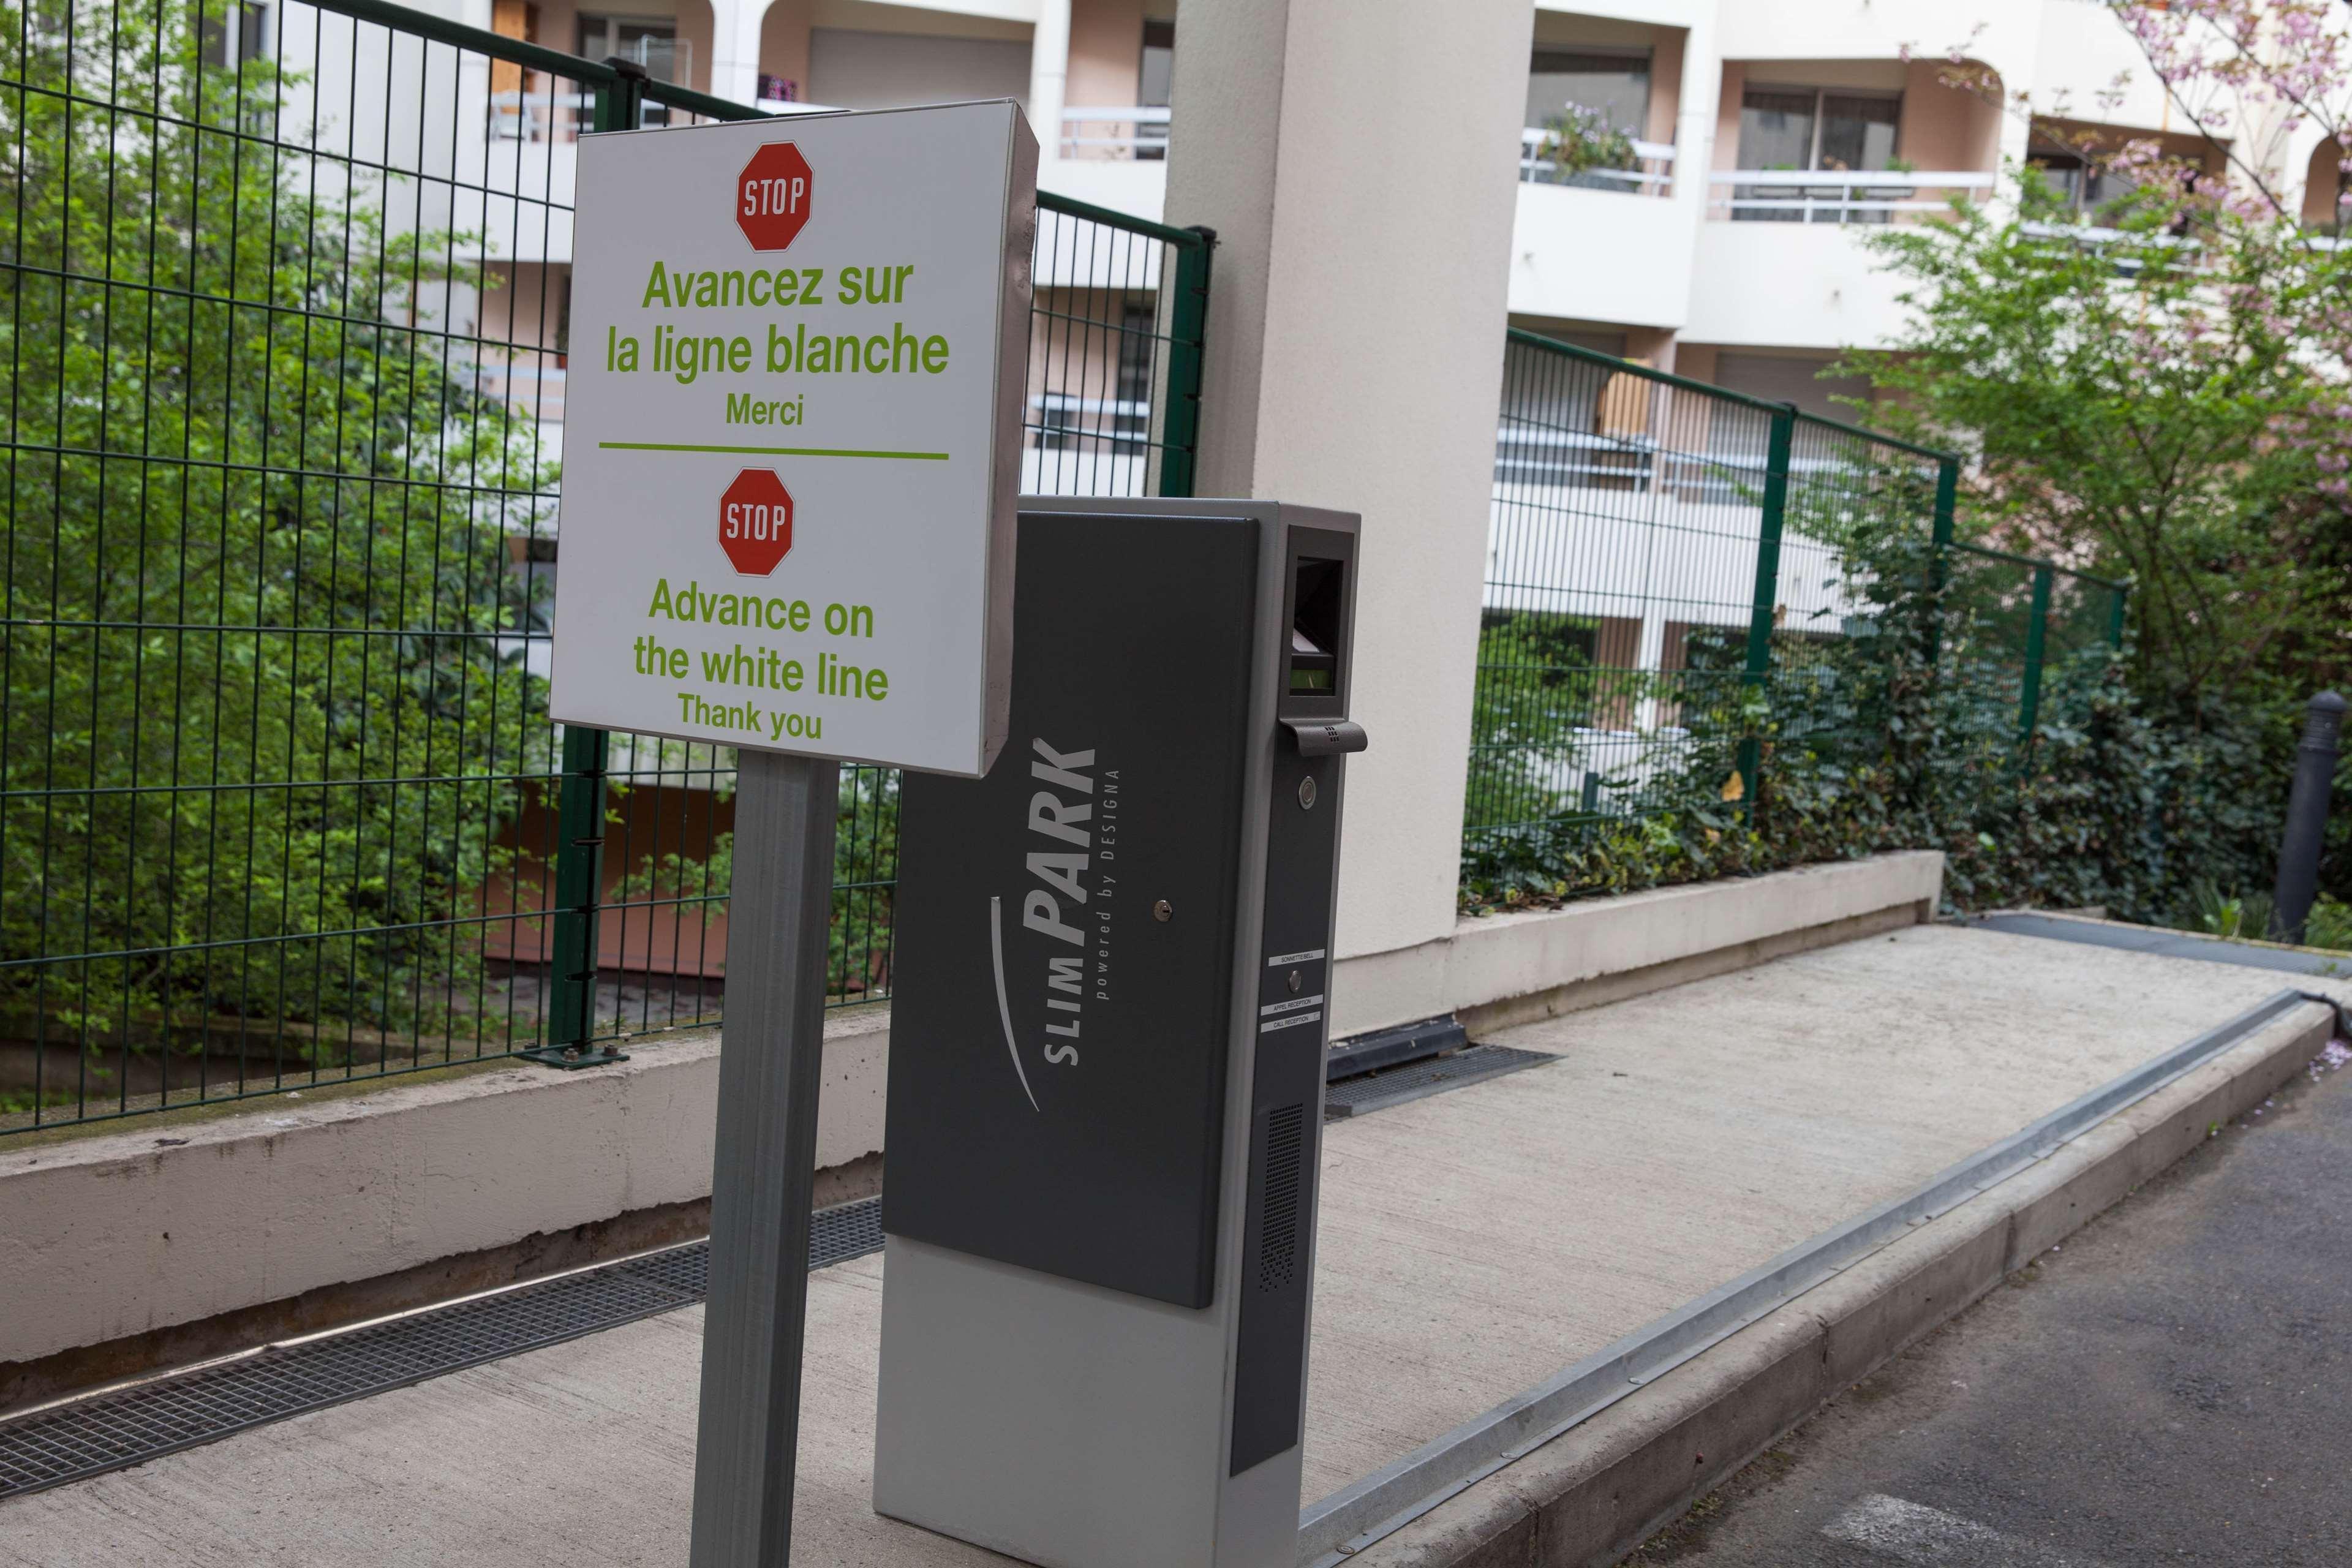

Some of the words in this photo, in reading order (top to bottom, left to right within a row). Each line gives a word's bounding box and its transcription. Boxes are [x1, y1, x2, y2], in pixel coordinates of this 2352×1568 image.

[745, 178, 804, 216] STOP
[643, 262, 823, 307] Avancez
[839, 265, 913, 304] sur
[608, 326, 638, 372] la
[654, 326, 751, 384] ligne
[767, 323, 948, 373] blanche
[727, 393, 803, 424] Merci
[727, 503, 785, 540] STOP
[649, 579, 810, 631] Advance
[825, 604, 872, 637] on
[634, 636, 688, 679] the
[702, 645, 803, 692] white
[818, 653, 888, 700] line
[678, 693, 761, 731] Thank
[771, 712, 821, 741] you
[1101, 771, 1118, 859] DESIGNA
[1097, 876, 1115, 897] by
[1096, 912, 1110, 1000] powered
[1285, 1016, 1308, 1025] RECEPTION
[1288, 999, 1311, 1008] RECEPTION
